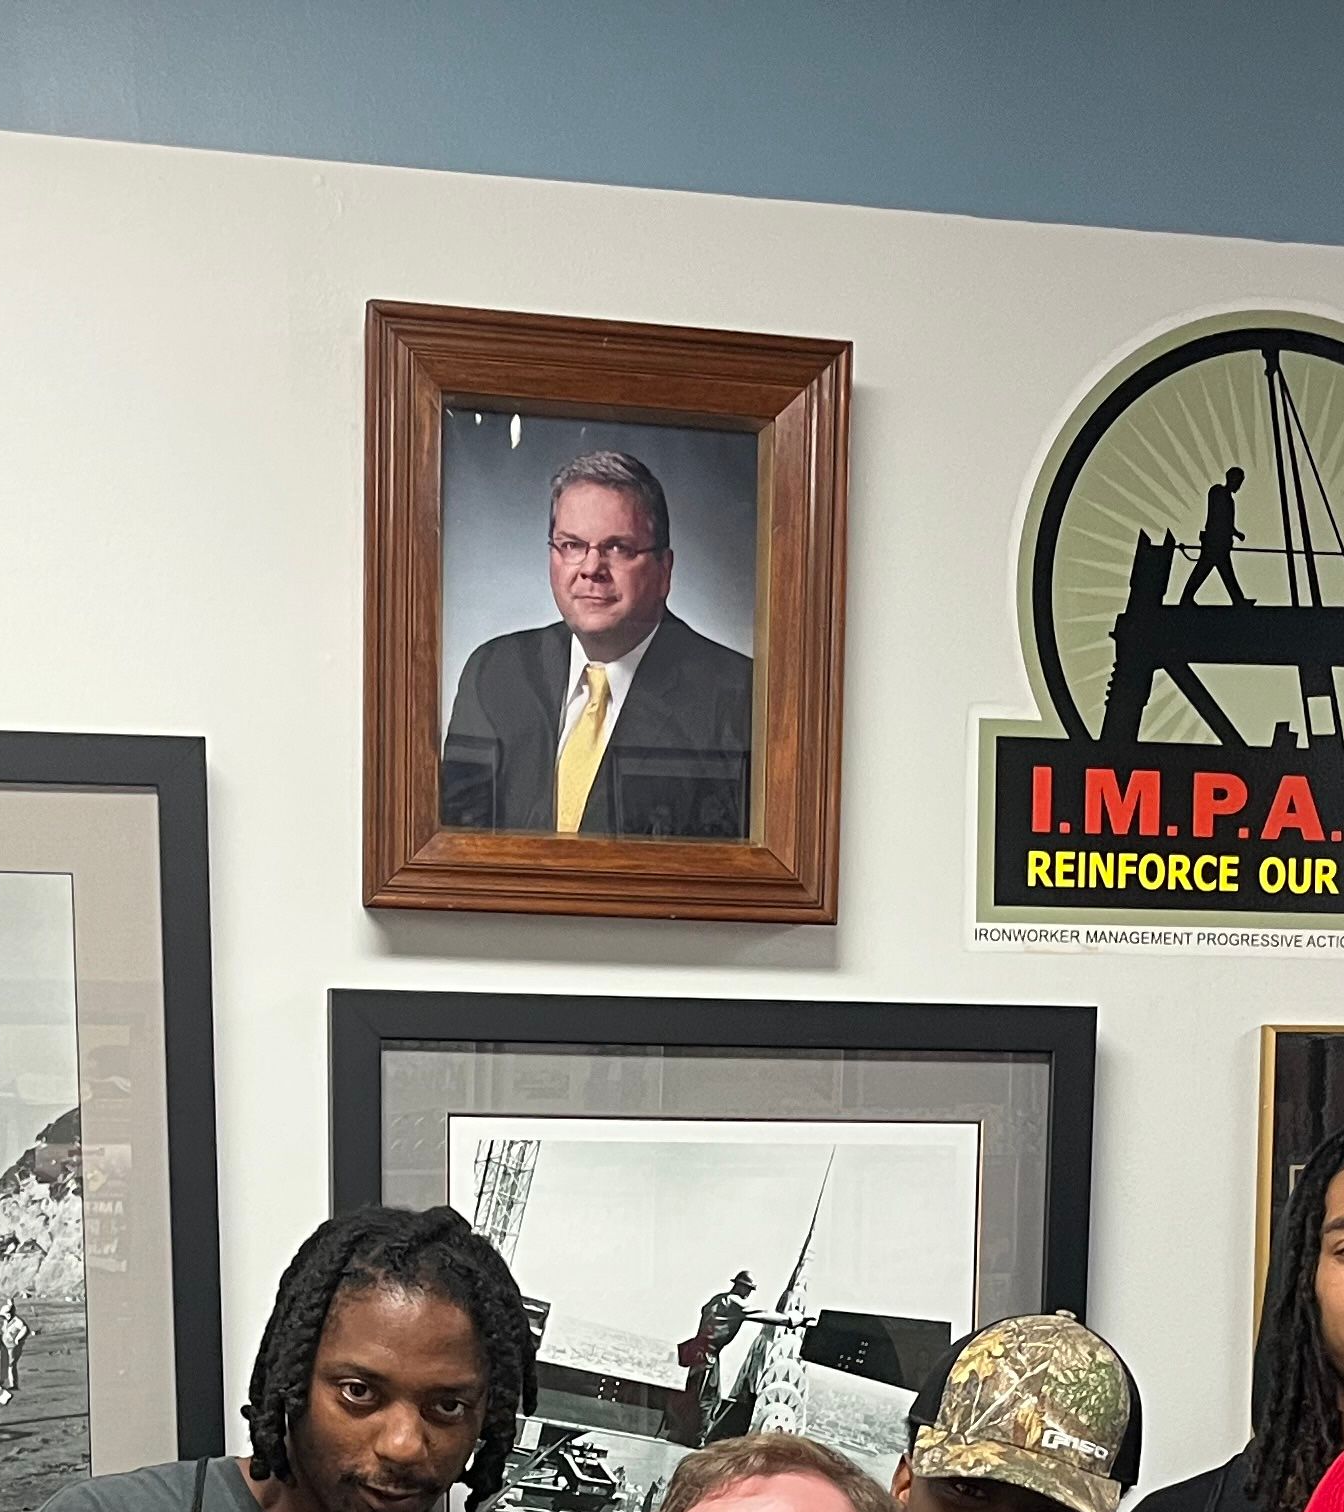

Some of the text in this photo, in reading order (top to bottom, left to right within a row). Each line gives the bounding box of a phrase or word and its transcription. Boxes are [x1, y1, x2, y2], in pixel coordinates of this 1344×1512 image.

[1027, 850, 1240, 892] REINFORCE
[1258, 856, 1340, 895] OUR
[974, 927, 1081, 944] IRONWORKER
[1086, 929, 1193, 946] MANAGEMENT
[1197, 932, 1303, 949] PROGRESSIVE
